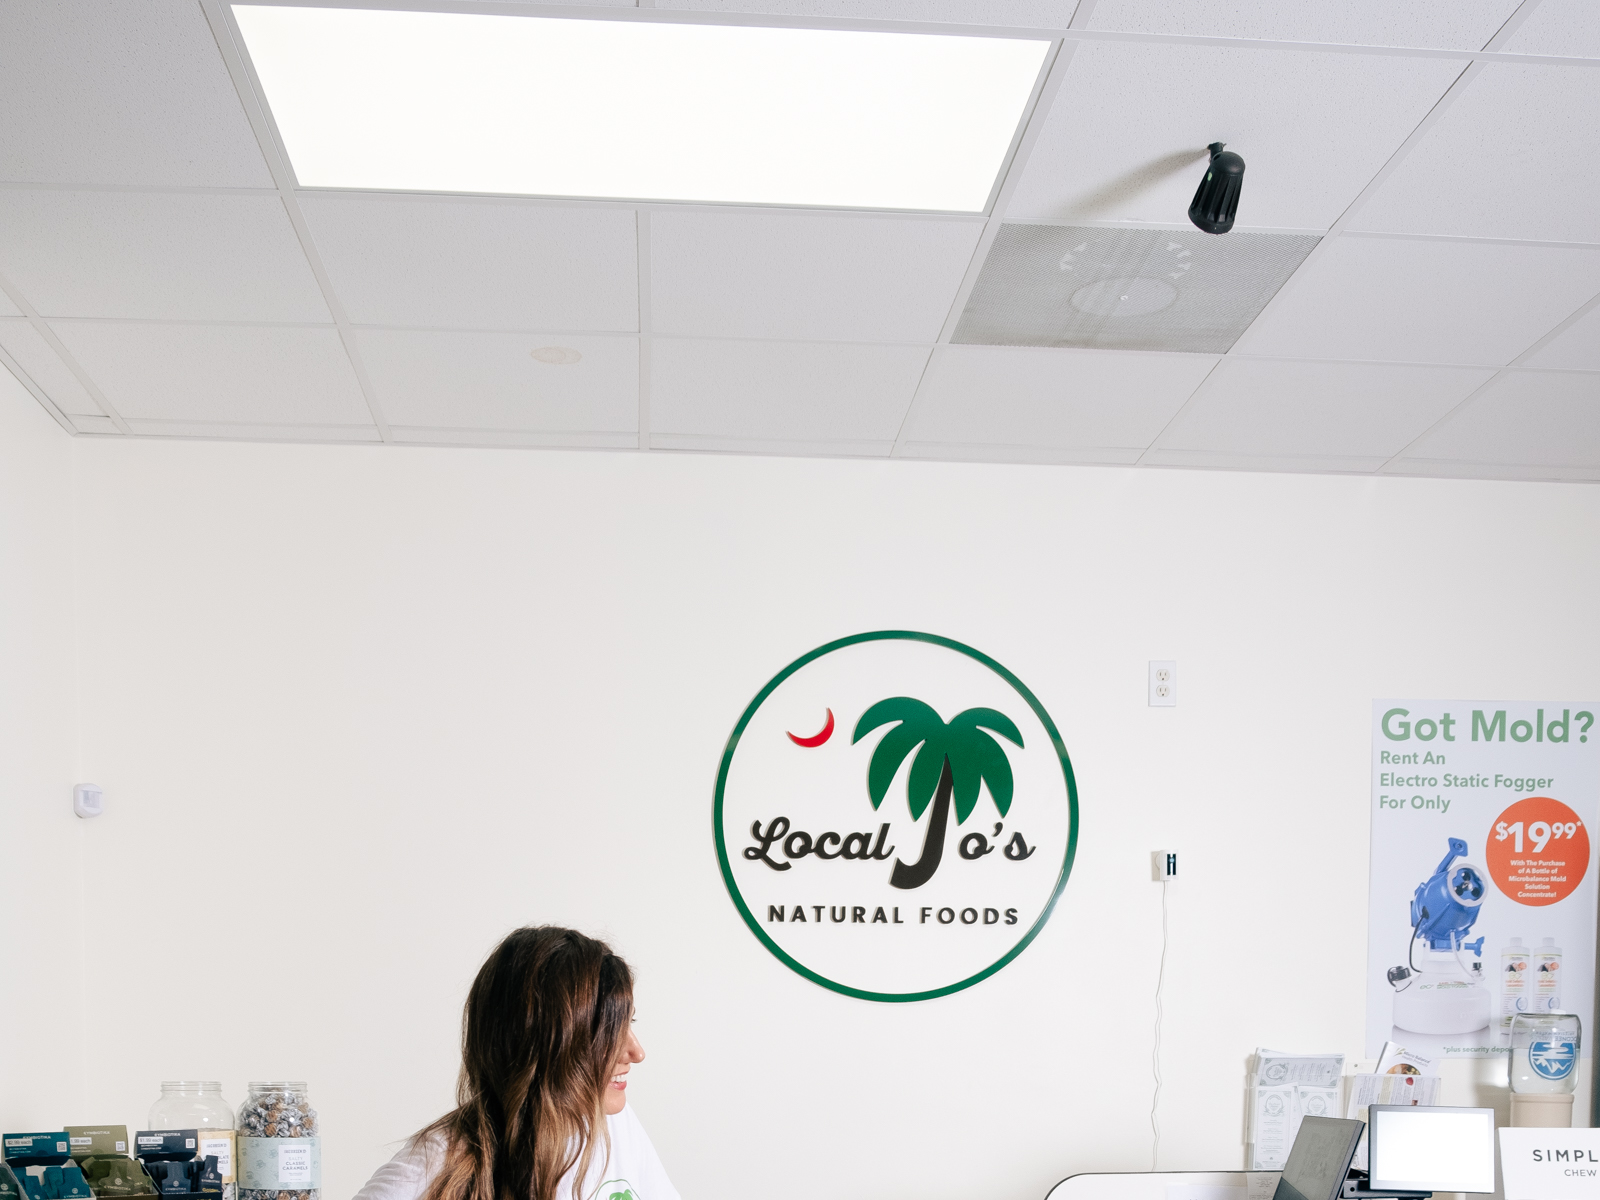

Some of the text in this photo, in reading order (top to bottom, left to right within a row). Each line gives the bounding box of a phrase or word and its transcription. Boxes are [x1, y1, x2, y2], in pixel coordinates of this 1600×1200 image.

[1382, 708, 1594, 743] Got Mold?
[1380, 751, 1446, 765] Rent An
[1380, 772, 1554, 792] Electro Static Fogger
[1380, 795, 1451, 813] For Only
[743, 816, 895, 872] Local
[768, 904, 1019, 926] NATURAL FOODS
[1533, 1149, 1598, 1162] SIMPL
[1564, 1169, 1597, 1177] CHEW
